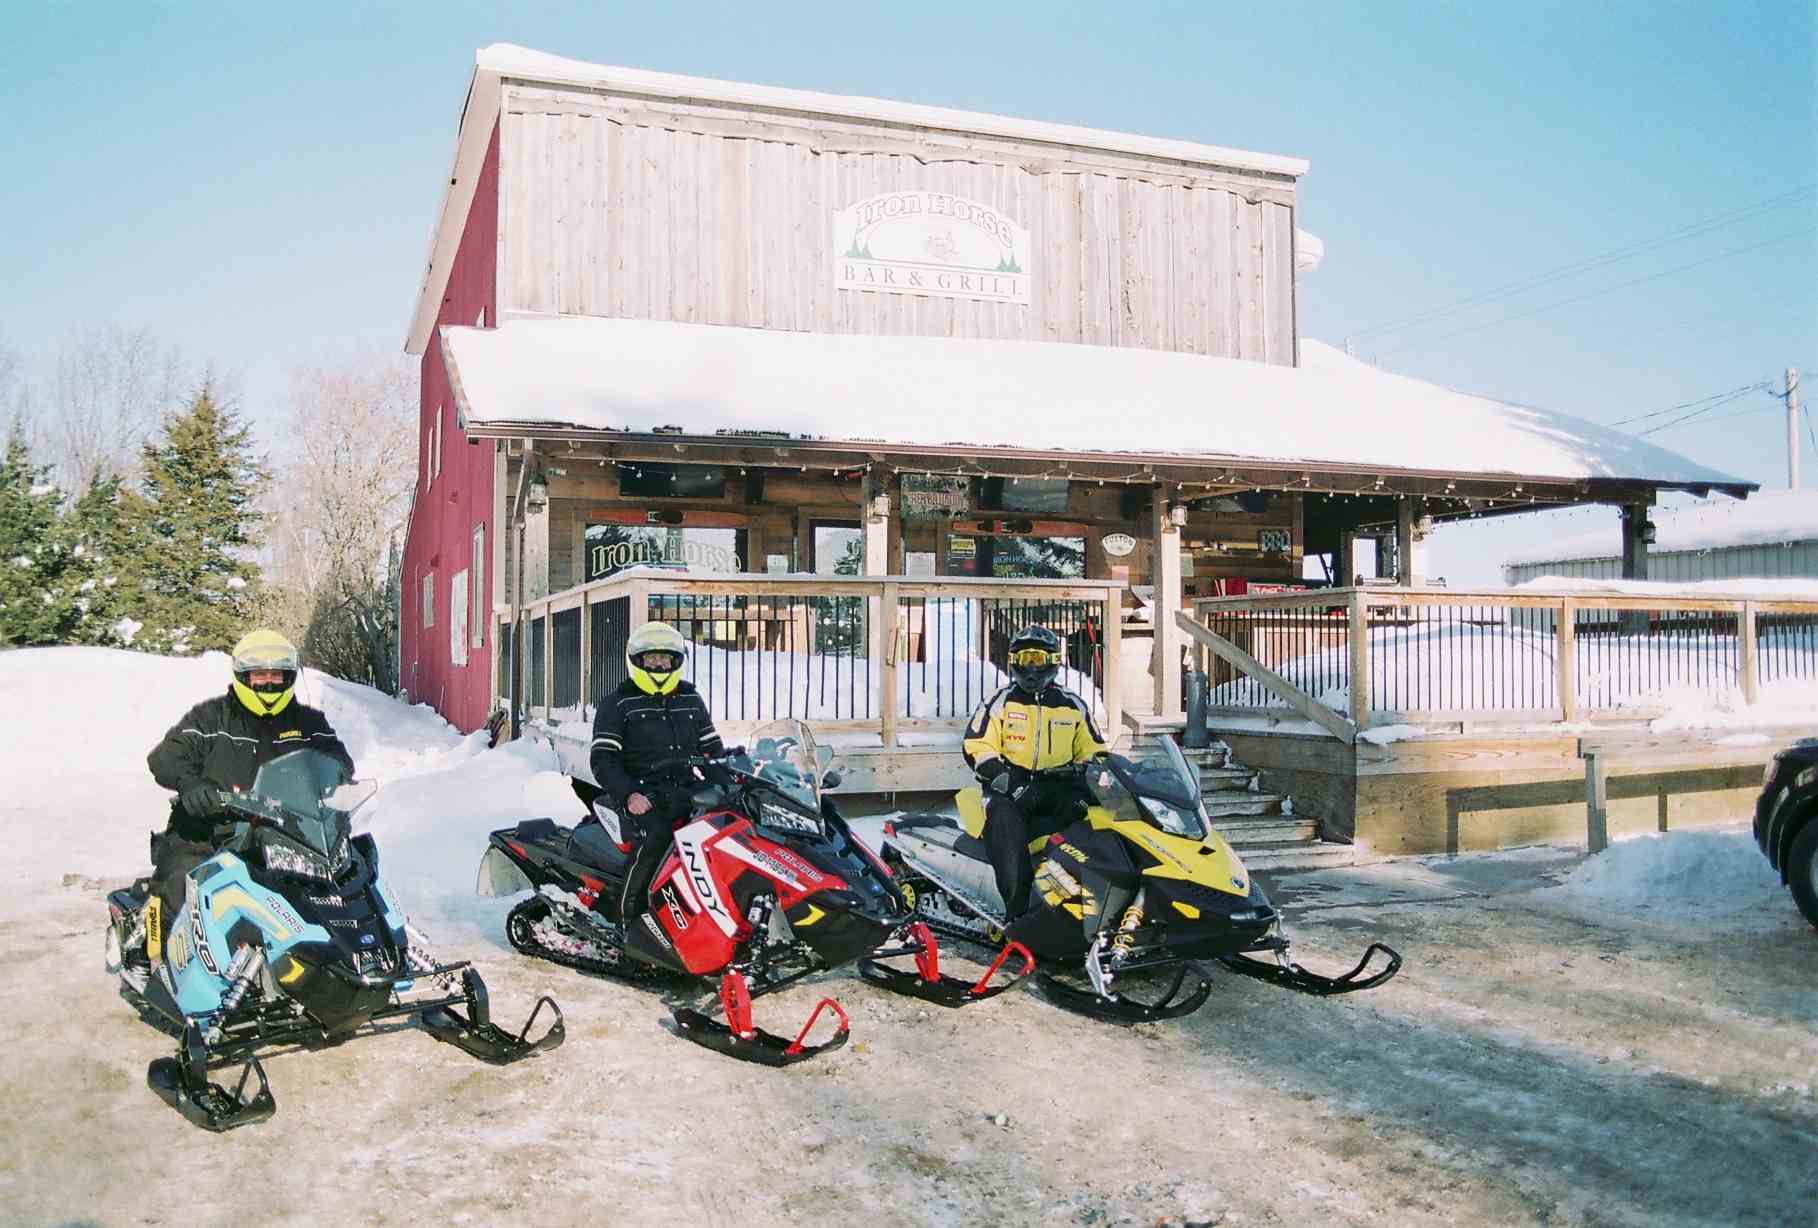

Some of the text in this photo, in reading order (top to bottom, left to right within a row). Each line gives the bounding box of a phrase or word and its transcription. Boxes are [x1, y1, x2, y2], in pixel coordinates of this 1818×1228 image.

[856, 193, 1013, 249] Iron Horse
[843, 264, 1023, 296] BAR & GRILL
[592, 541, 650, 576] Iron
[682, 841, 728, 917] INDY
[266, 895, 305, 934] POLARIS
